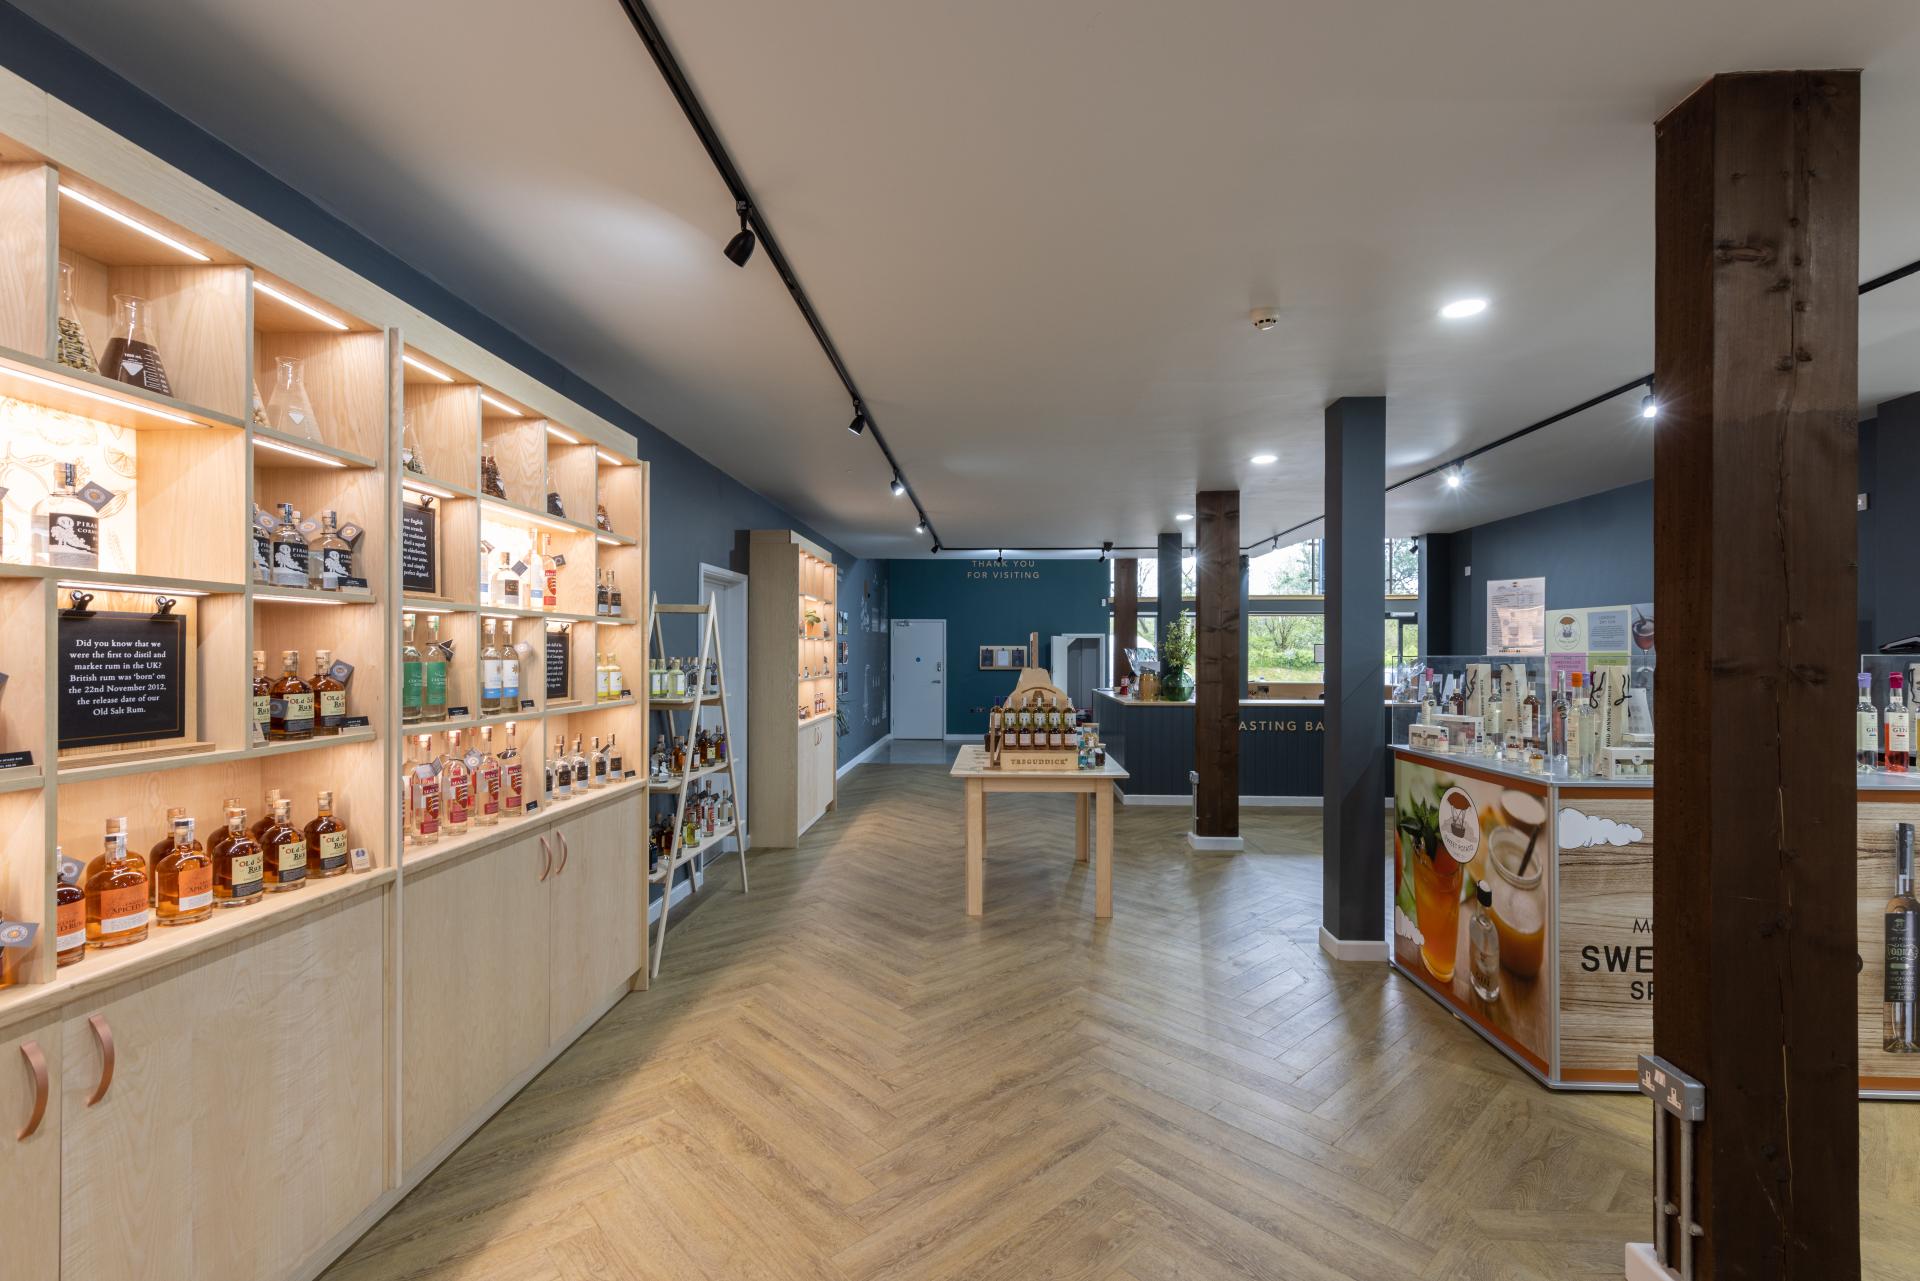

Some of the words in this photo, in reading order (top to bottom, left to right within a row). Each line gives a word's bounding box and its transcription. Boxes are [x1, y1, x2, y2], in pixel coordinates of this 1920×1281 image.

[972, 560, 1008, 568] THANK
[1013, 560, 1035, 568] YOU
[967, 571, 988, 579] FOR
[992, 571, 1040, 579] VISITING
[76, 639, 92, 647] Did
[94, 640, 109, 649] you
[111, 639, 133, 647] know
[74, 662, 102, 670] market
[70, 674, 97, 682] British
[68, 686, 82, 694] the
[84, 685, 104, 693] 22nd
[106, 684, 146, 692] November
[77, 697, 90, 705] the
[93, 708, 108, 716] Old
[110, 707, 124, 715] Salt
[1239, 721, 1297, 731] ASTING
[1305, 721, 1325, 731] BA
[1581, 945, 1654, 973] SWE
